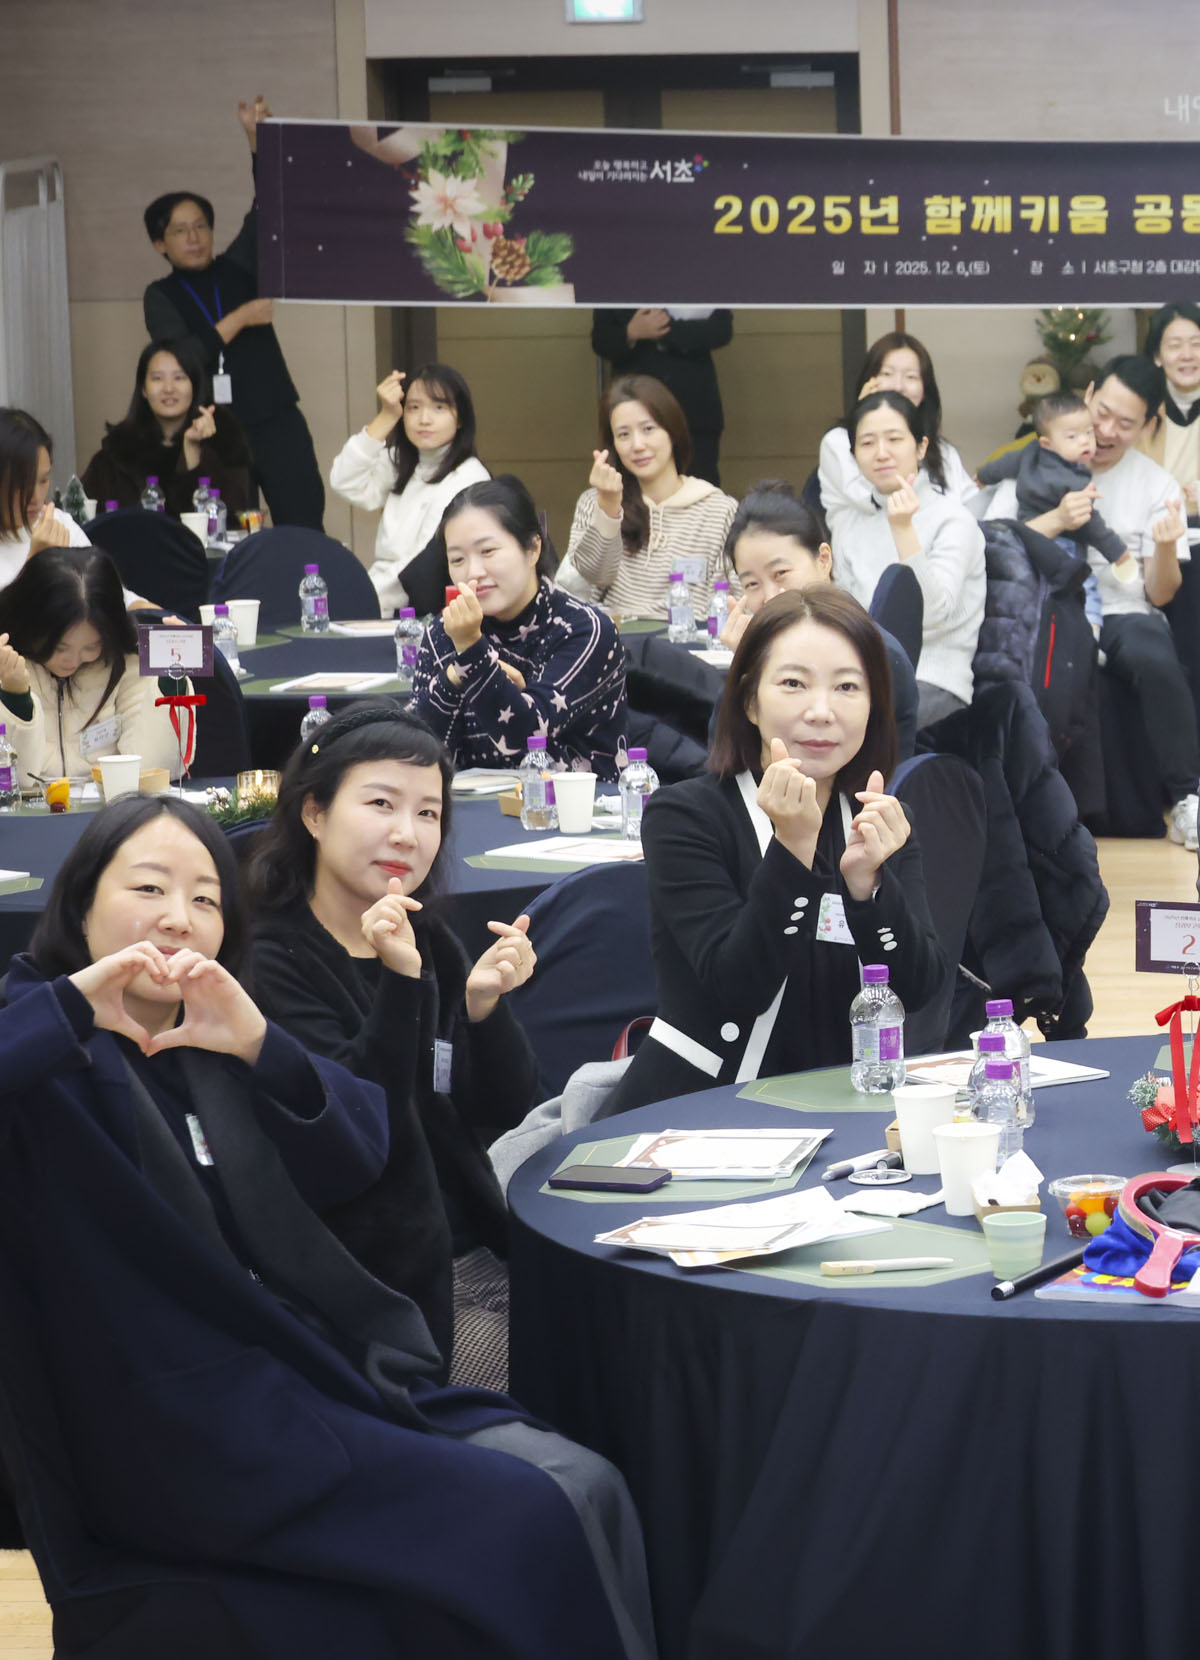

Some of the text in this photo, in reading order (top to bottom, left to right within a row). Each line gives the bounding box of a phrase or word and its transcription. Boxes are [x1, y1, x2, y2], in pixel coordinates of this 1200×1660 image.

[649, 158, 695, 184] 서초
[713, 194, 900, 235] 2025년
[924, 194, 1109, 235] 함께키움
[170, 647, 183, 663] 5
[1181, 934, 1197, 955] 2
